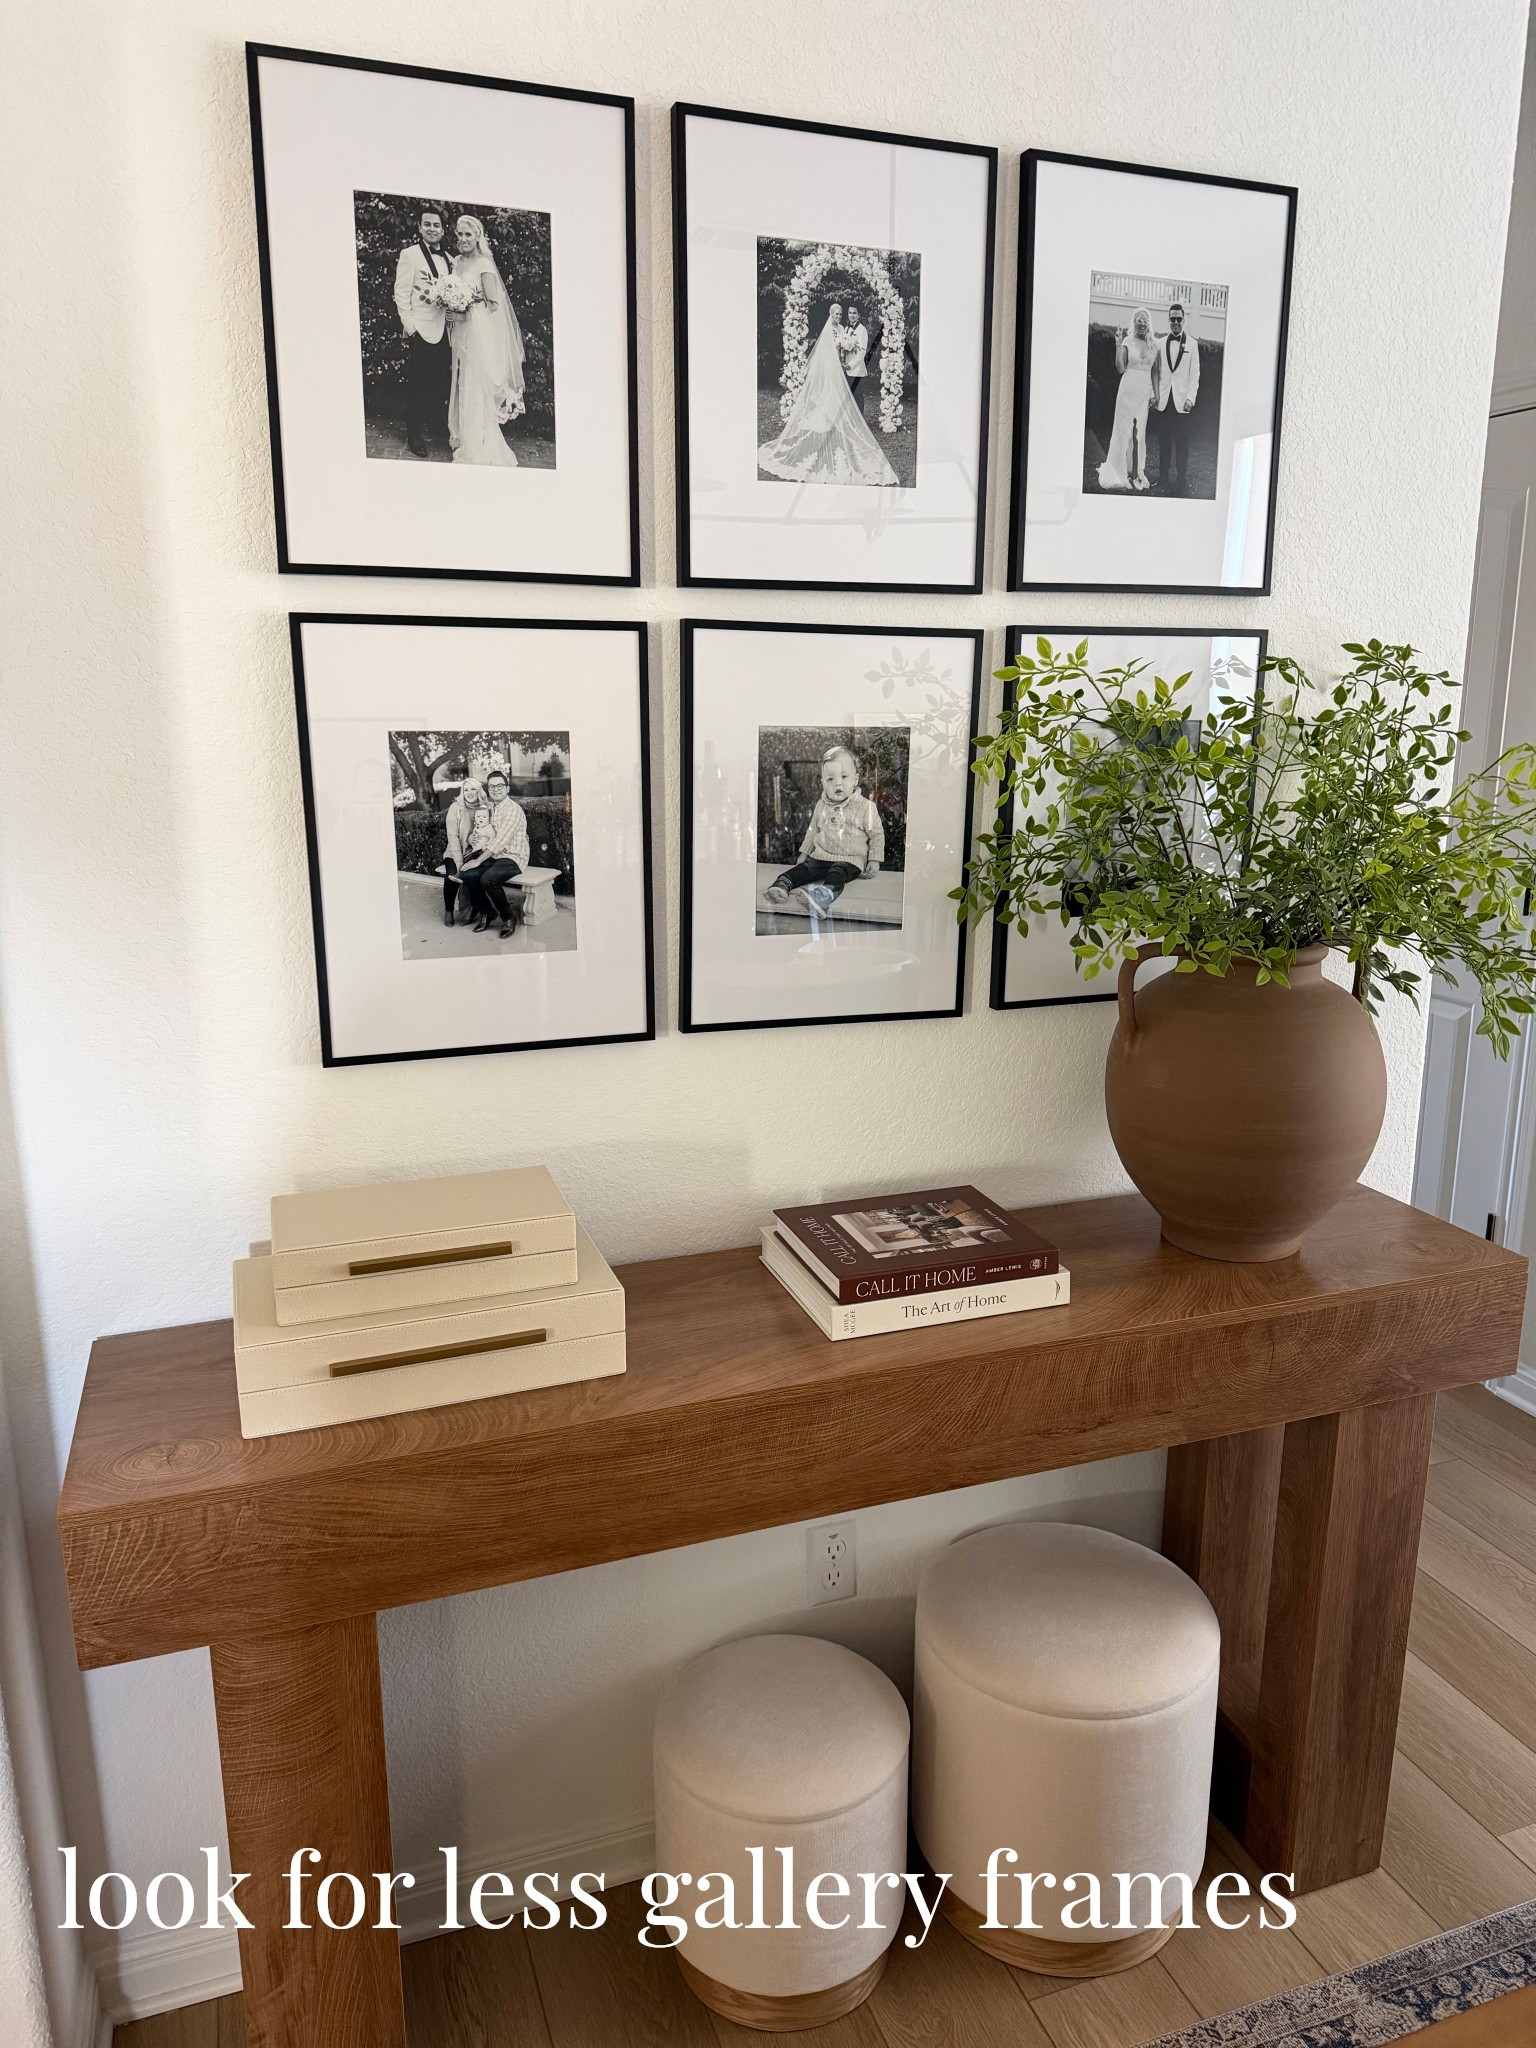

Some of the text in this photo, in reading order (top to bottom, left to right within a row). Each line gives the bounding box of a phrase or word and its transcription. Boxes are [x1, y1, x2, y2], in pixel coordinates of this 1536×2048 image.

[829, 1245, 857, 1265] CALL
[985, 1265, 1004, 1274] AMBER
[856, 1266, 977, 1298] CALL IT HOME
[902, 1294, 1007, 1318] The Art of Home
